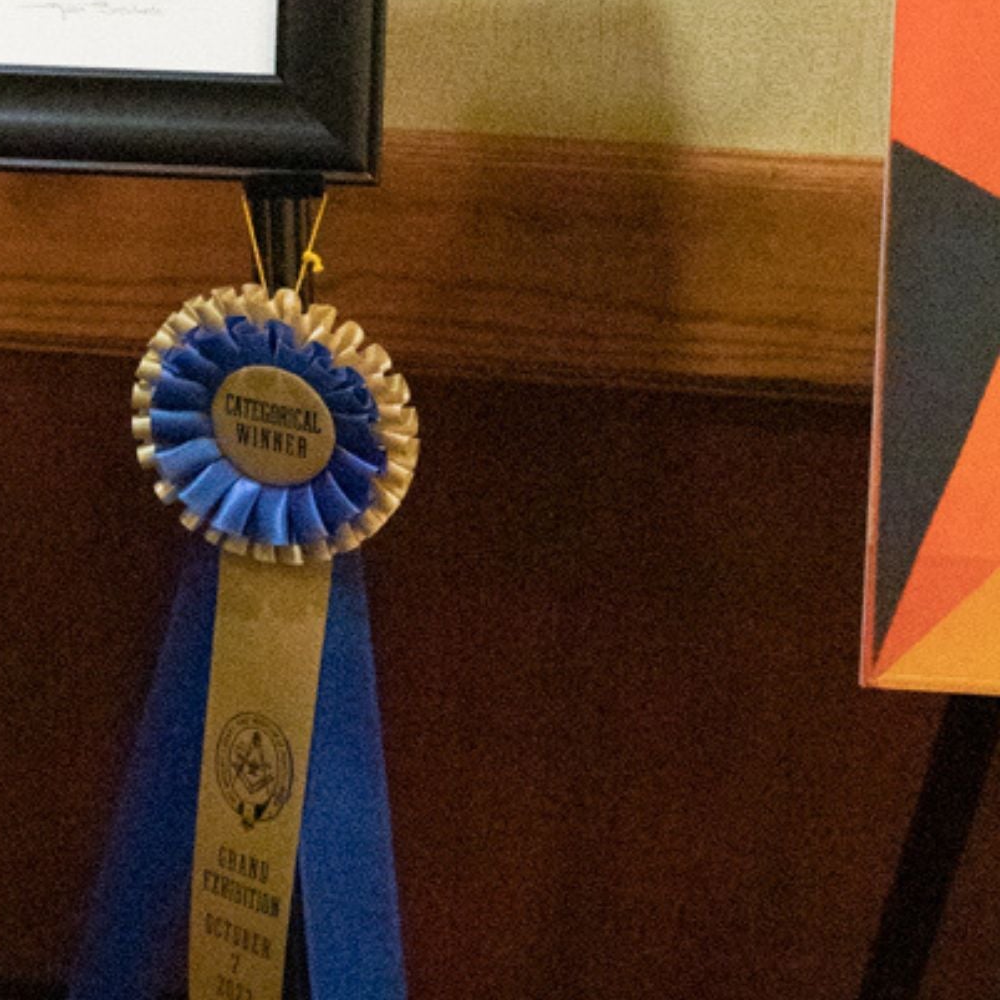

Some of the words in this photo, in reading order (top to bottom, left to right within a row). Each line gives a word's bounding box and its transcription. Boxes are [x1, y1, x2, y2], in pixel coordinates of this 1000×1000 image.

[226, 393, 322, 434] CATEGORICAL
[236, 422, 308, 459] WINNER
[217, 845, 270, 884] GRAND
[205, 911, 272, 960] OCTOBER
